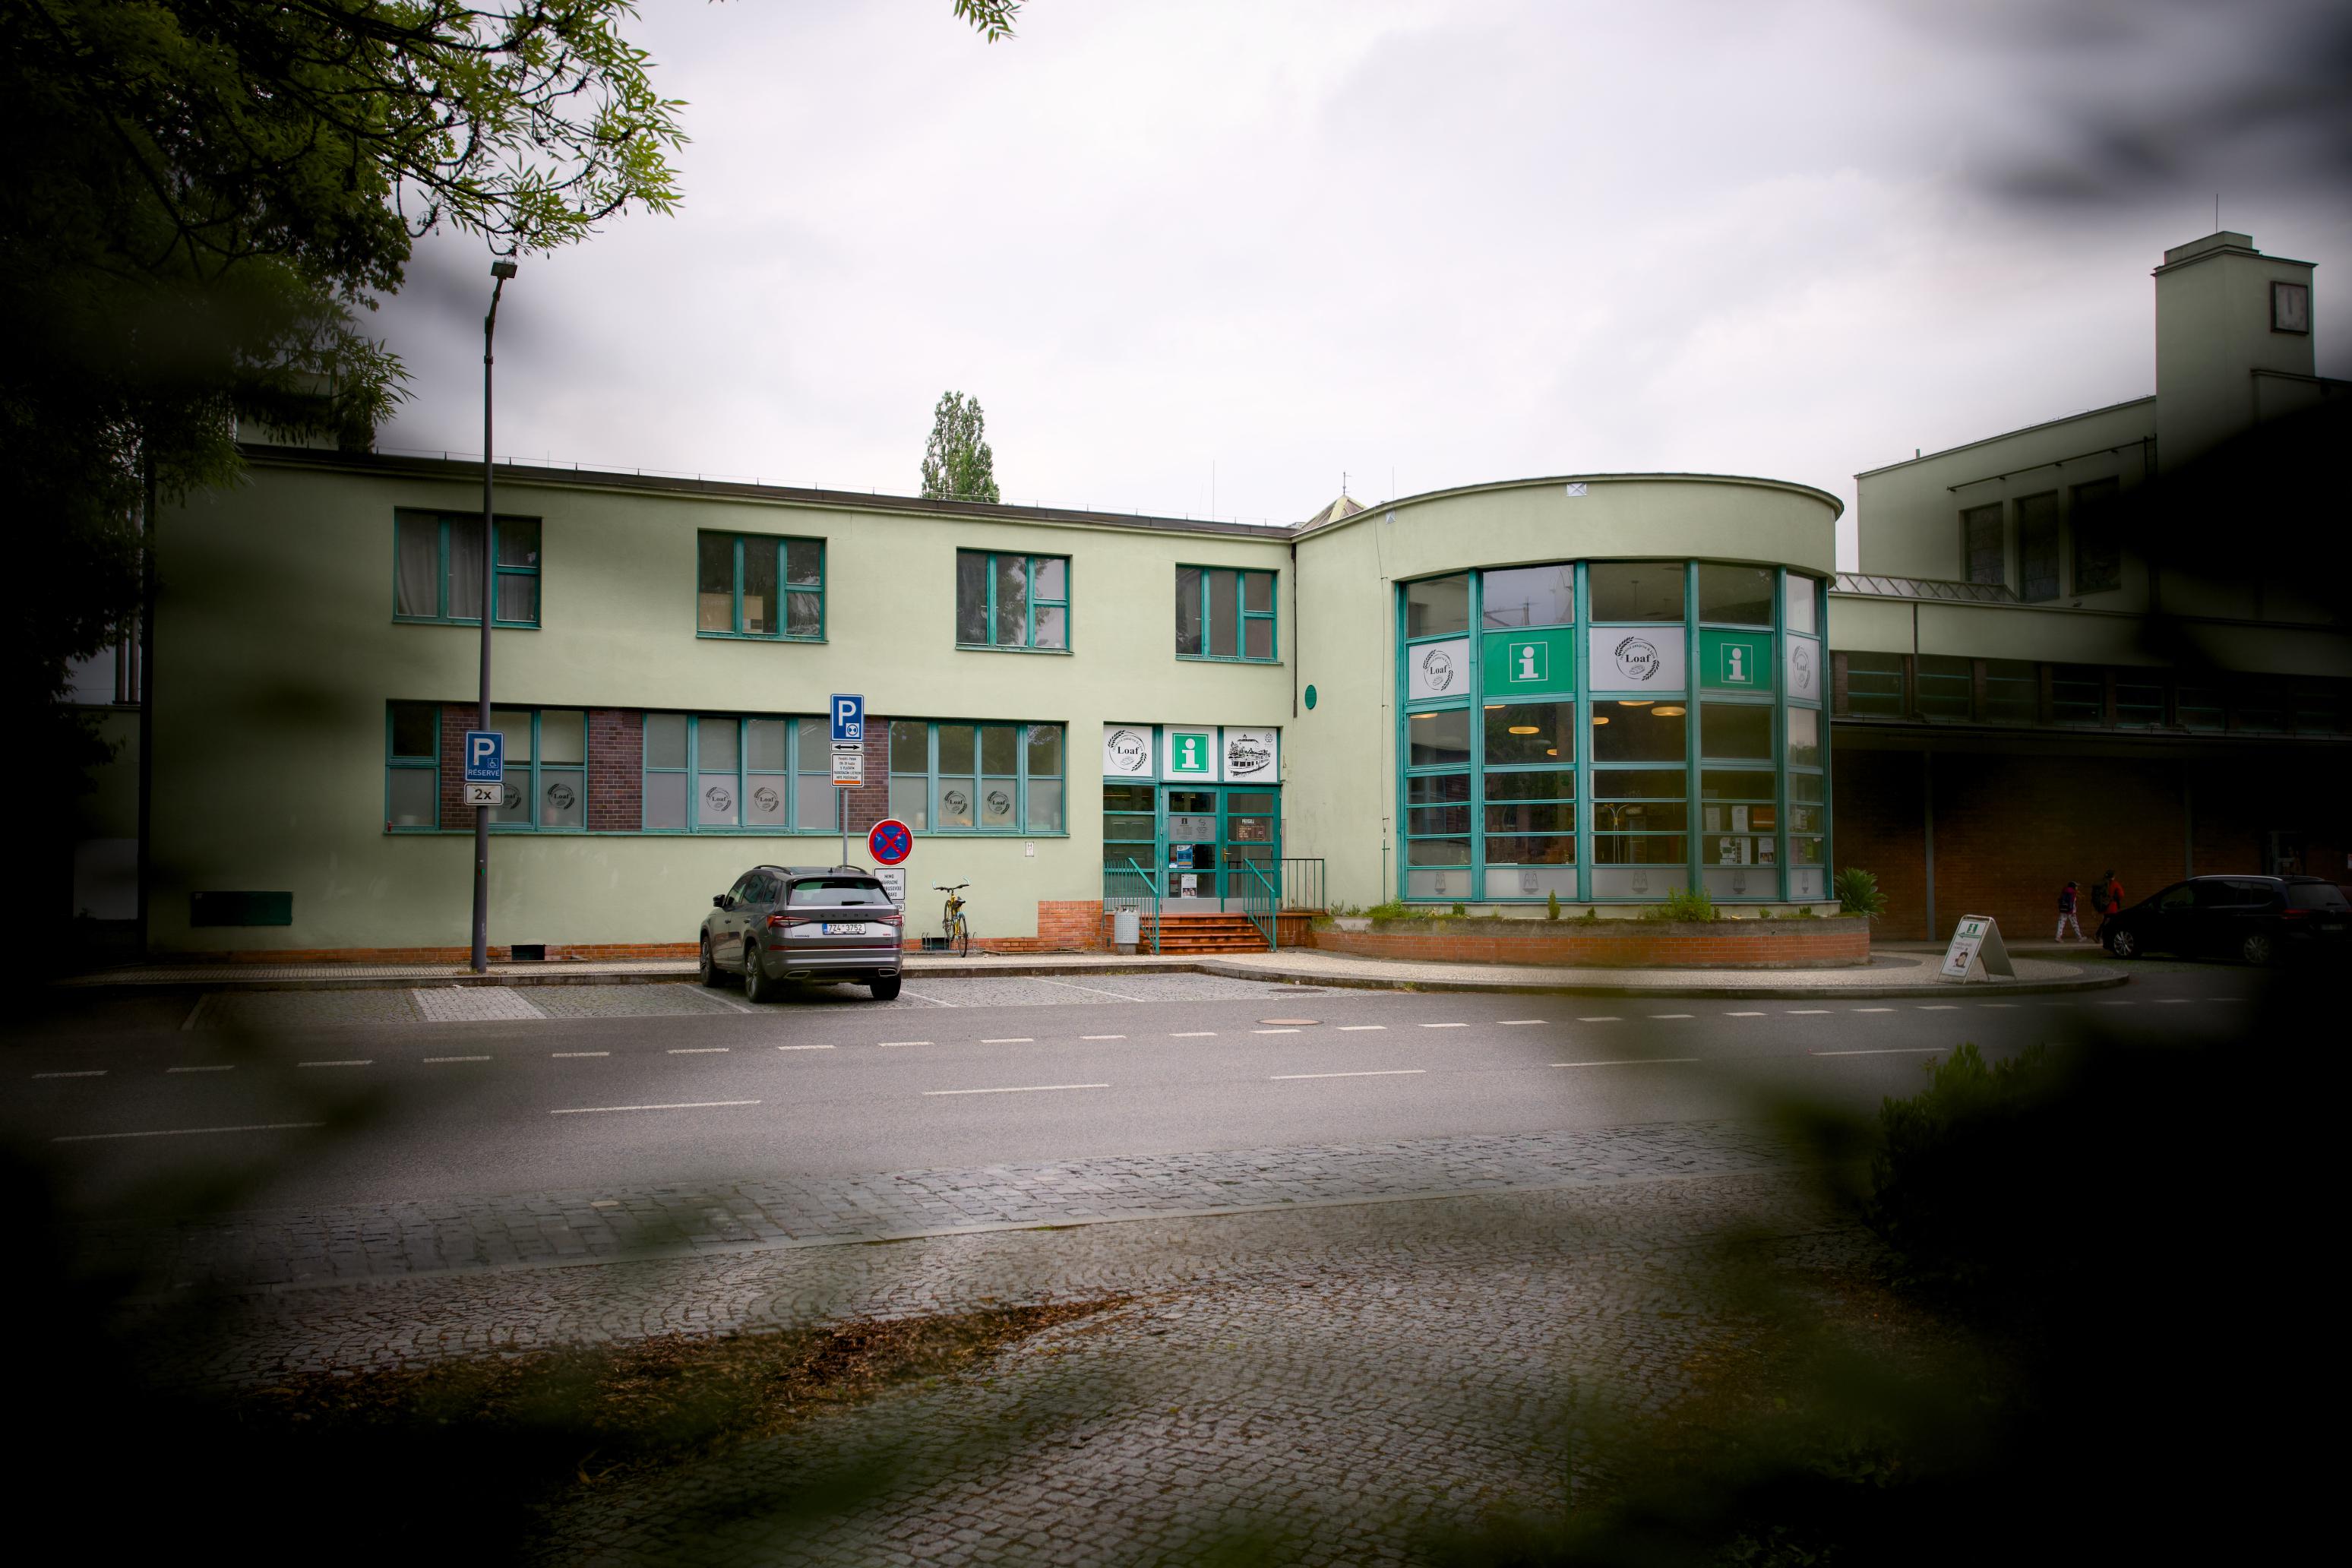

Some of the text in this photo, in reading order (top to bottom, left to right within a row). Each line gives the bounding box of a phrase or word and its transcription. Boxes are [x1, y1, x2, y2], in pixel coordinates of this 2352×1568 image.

[1626, 654, 1652, 662] Loaf
[1430, 665, 1448, 675] Loaf
[838, 700, 857, 726] P
[473, 738, 495, 766] P
[1118, 746, 1140, 754] Loaf
[474, 789, 492, 800] 2x
